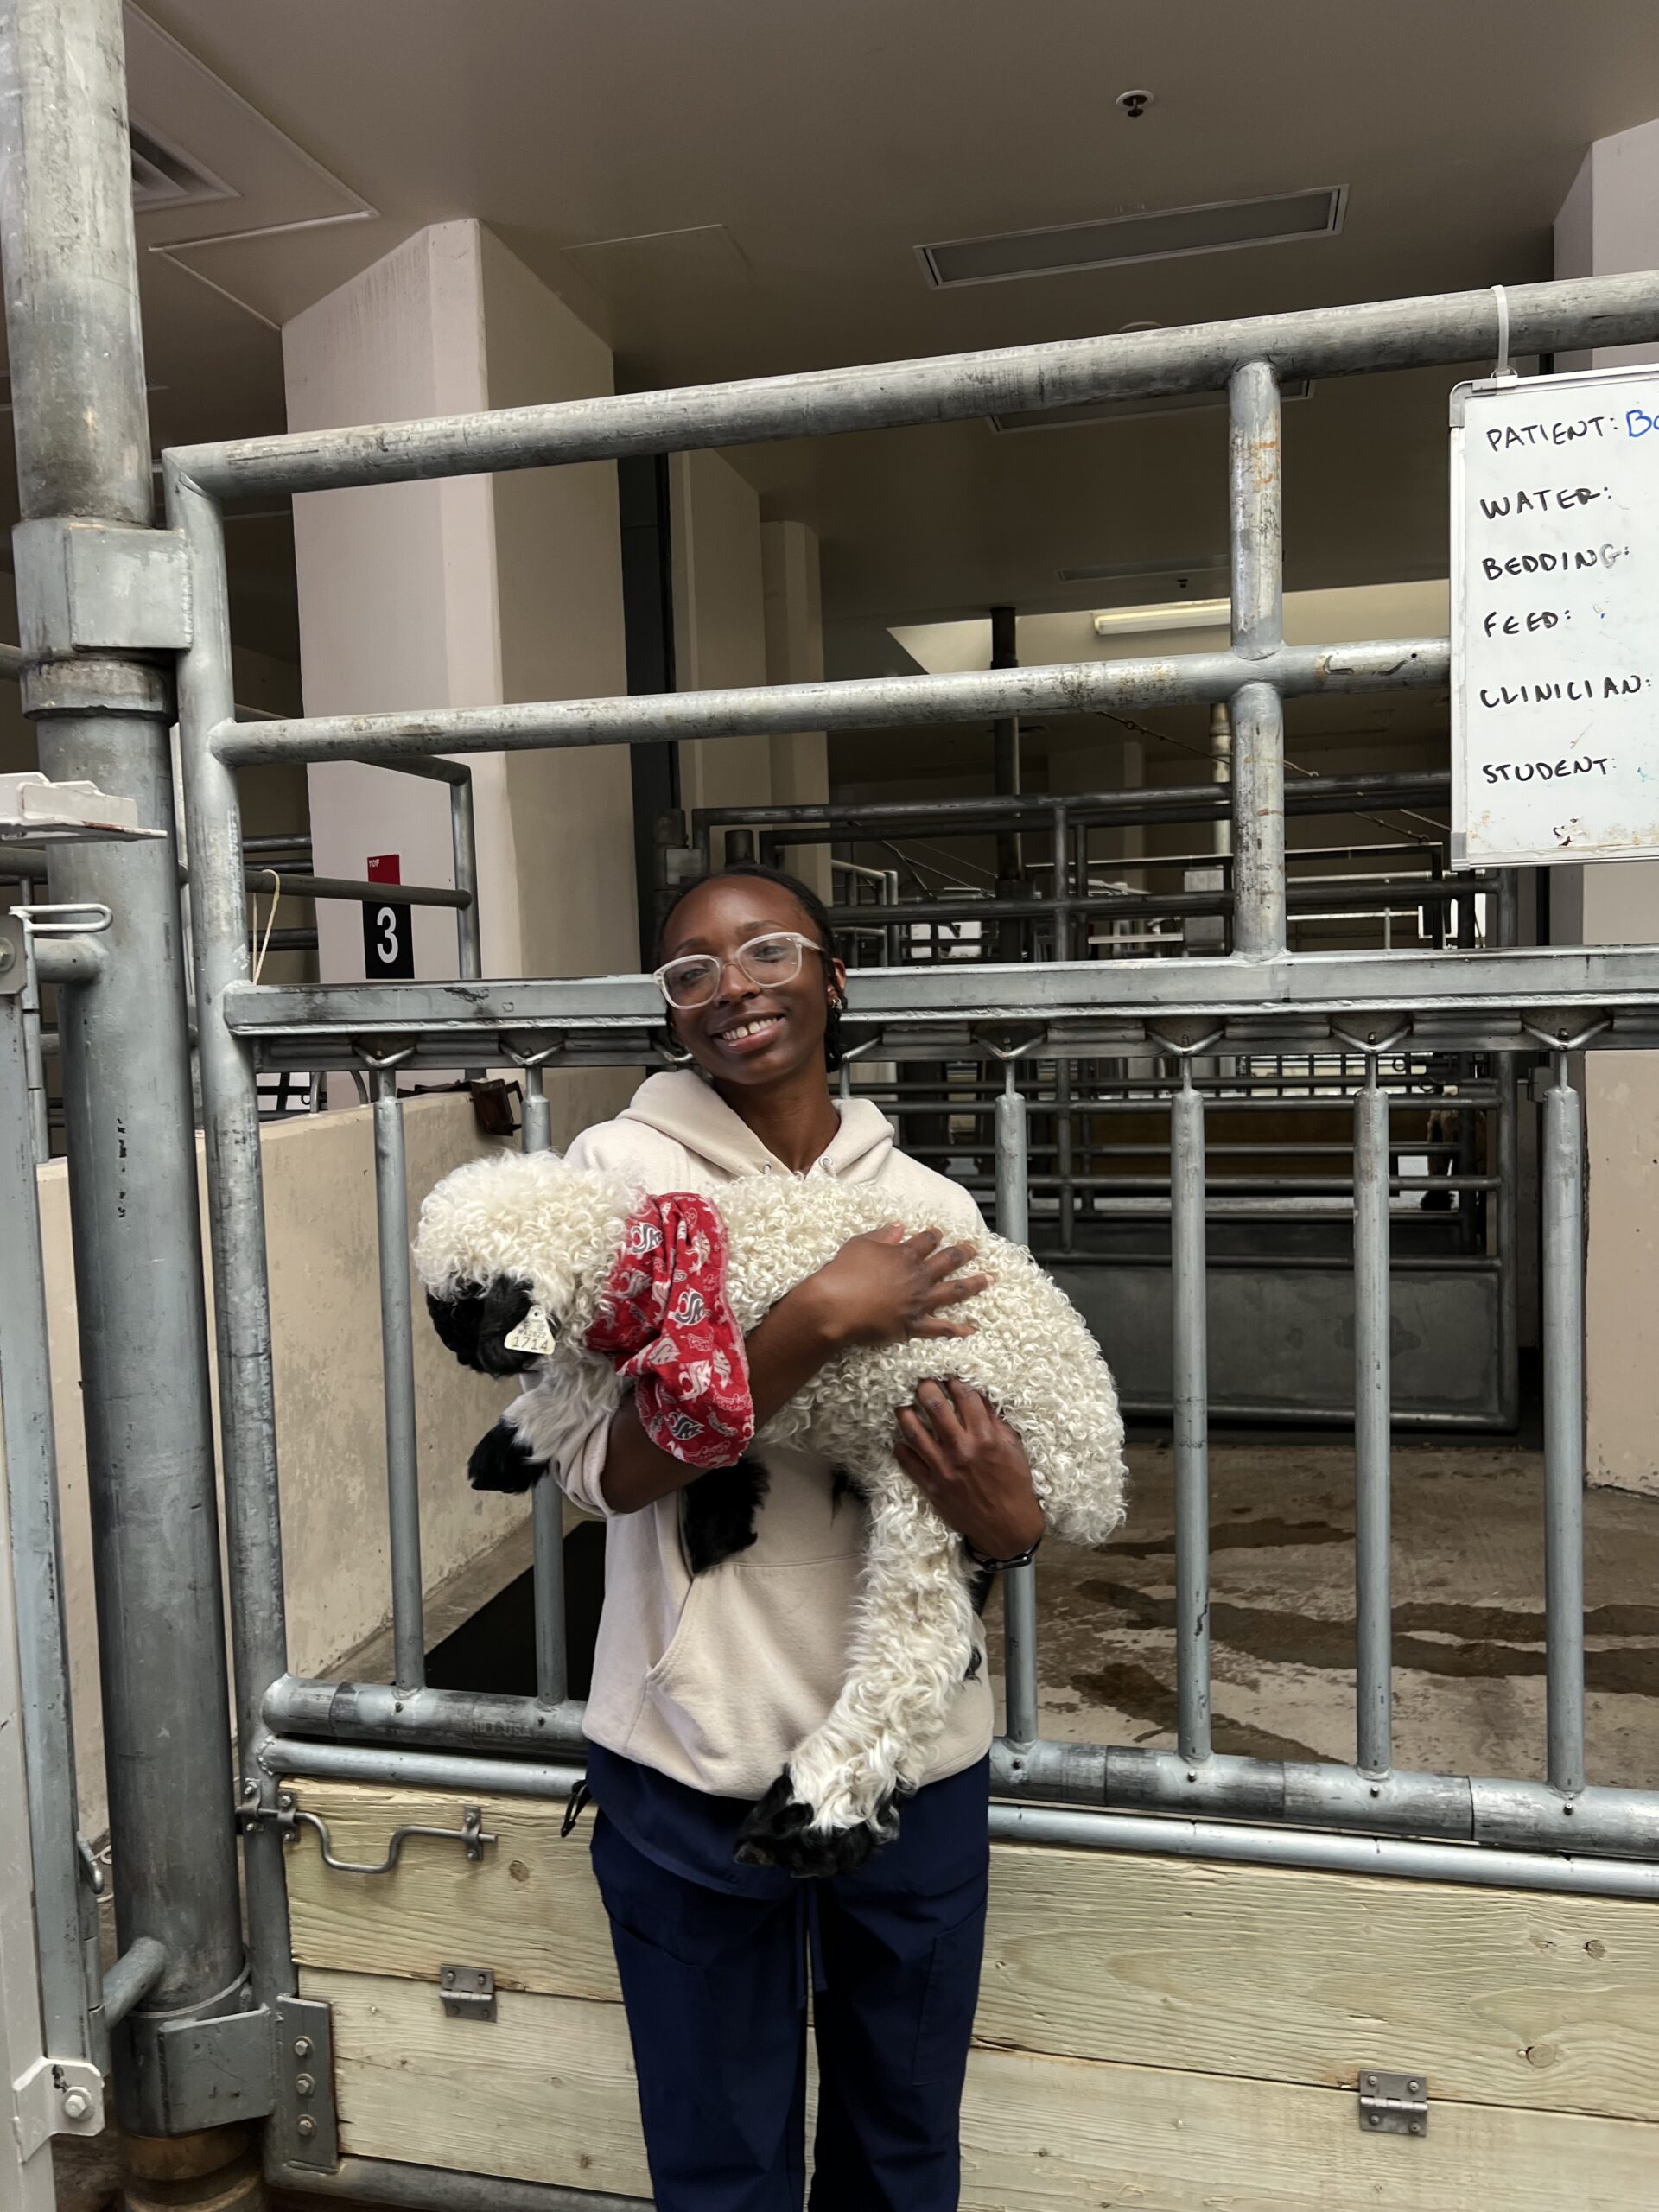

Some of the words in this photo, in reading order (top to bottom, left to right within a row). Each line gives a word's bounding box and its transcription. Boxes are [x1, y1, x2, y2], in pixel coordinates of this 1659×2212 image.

[1486, 416, 1618, 453] PATIENT:
[1479, 486, 1612, 520] WATER:
[1482, 543, 1630, 581] BEDDING:
[1484, 608, 1572, 638] FEED:
[1479, 675, 1652, 709] CLINICIAN:
[1482, 756, 1617, 784] STUDENT:
[376, 906, 399, 964] 3
[512, 1336, 548, 1351] 1714
